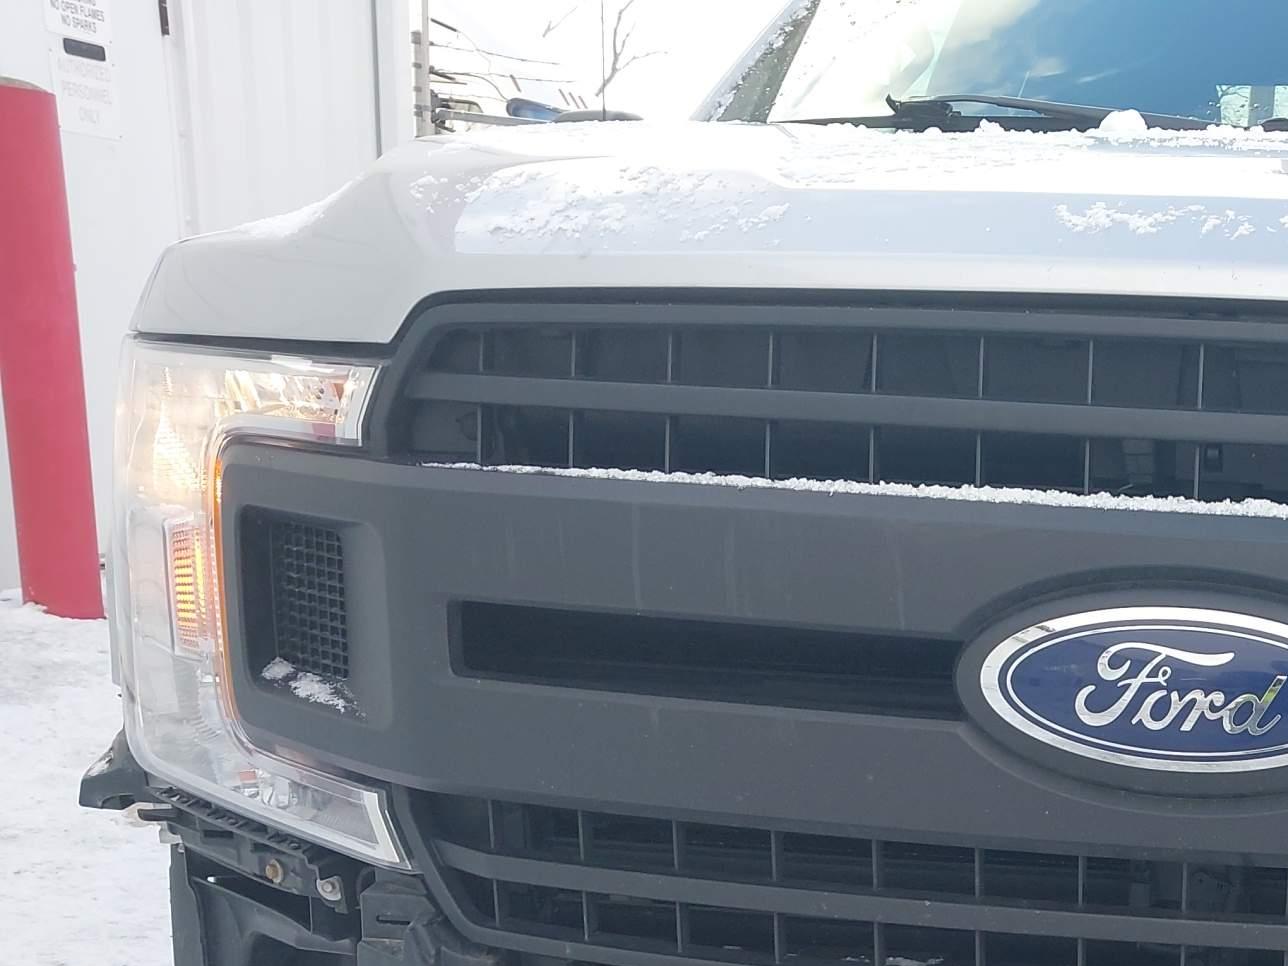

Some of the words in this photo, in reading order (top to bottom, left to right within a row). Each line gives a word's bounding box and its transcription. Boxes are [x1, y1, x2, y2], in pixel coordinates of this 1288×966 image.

[61, 1, 79, 15] OPEN
[80, 5, 105, 22] FLAMES
[61, 13, 71, 26] NO
[72, 16, 97, 34] SPARKS
[62, 80, 112, 105] PERSONNEL
[1074, 642, 1287, 736] Ford
